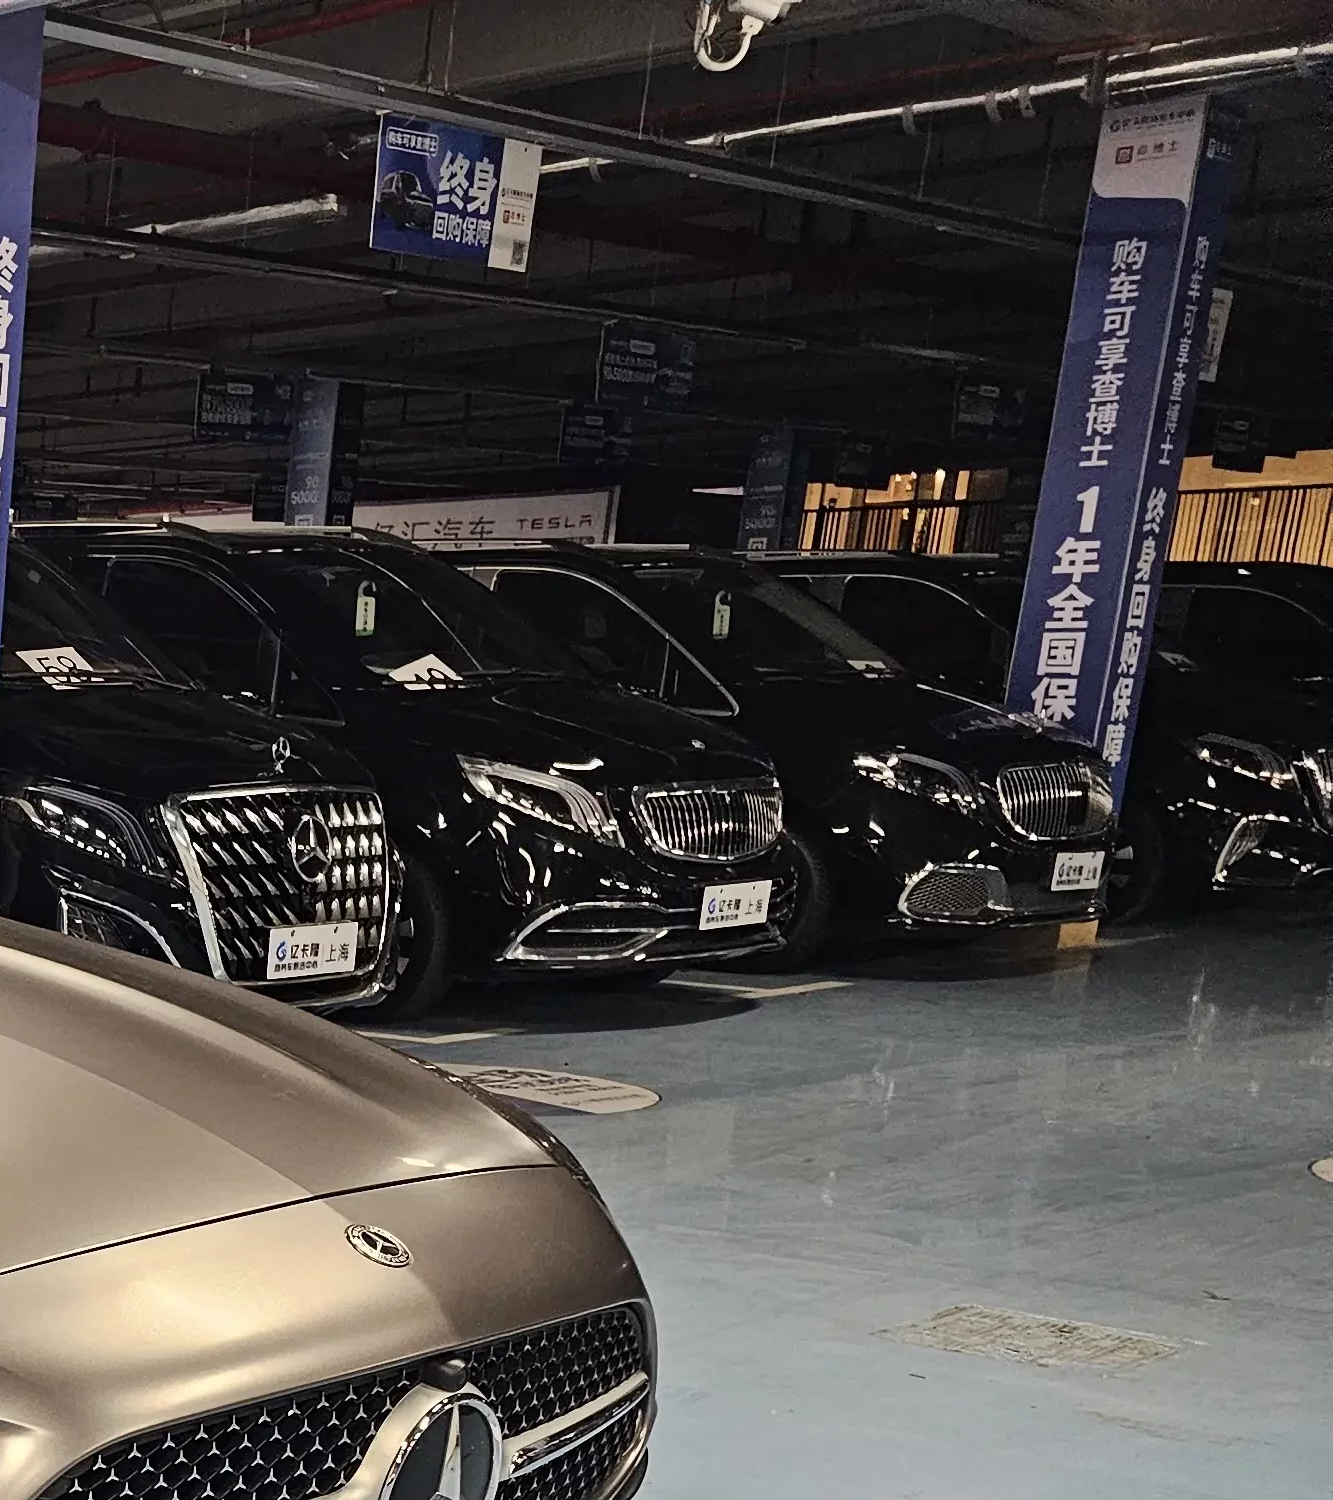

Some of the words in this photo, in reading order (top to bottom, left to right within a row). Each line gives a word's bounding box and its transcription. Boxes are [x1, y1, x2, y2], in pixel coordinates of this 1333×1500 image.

[436, 150, 497, 215] 终身
[433, 211, 491, 247] 回购保障
[1079, 237, 1148, 467] 购车可享查博士
[517, 515, 592, 531] TESLA
[1102, 487, 1167, 767] 终身回购保障
[325, 943, 350, 962] 上海
